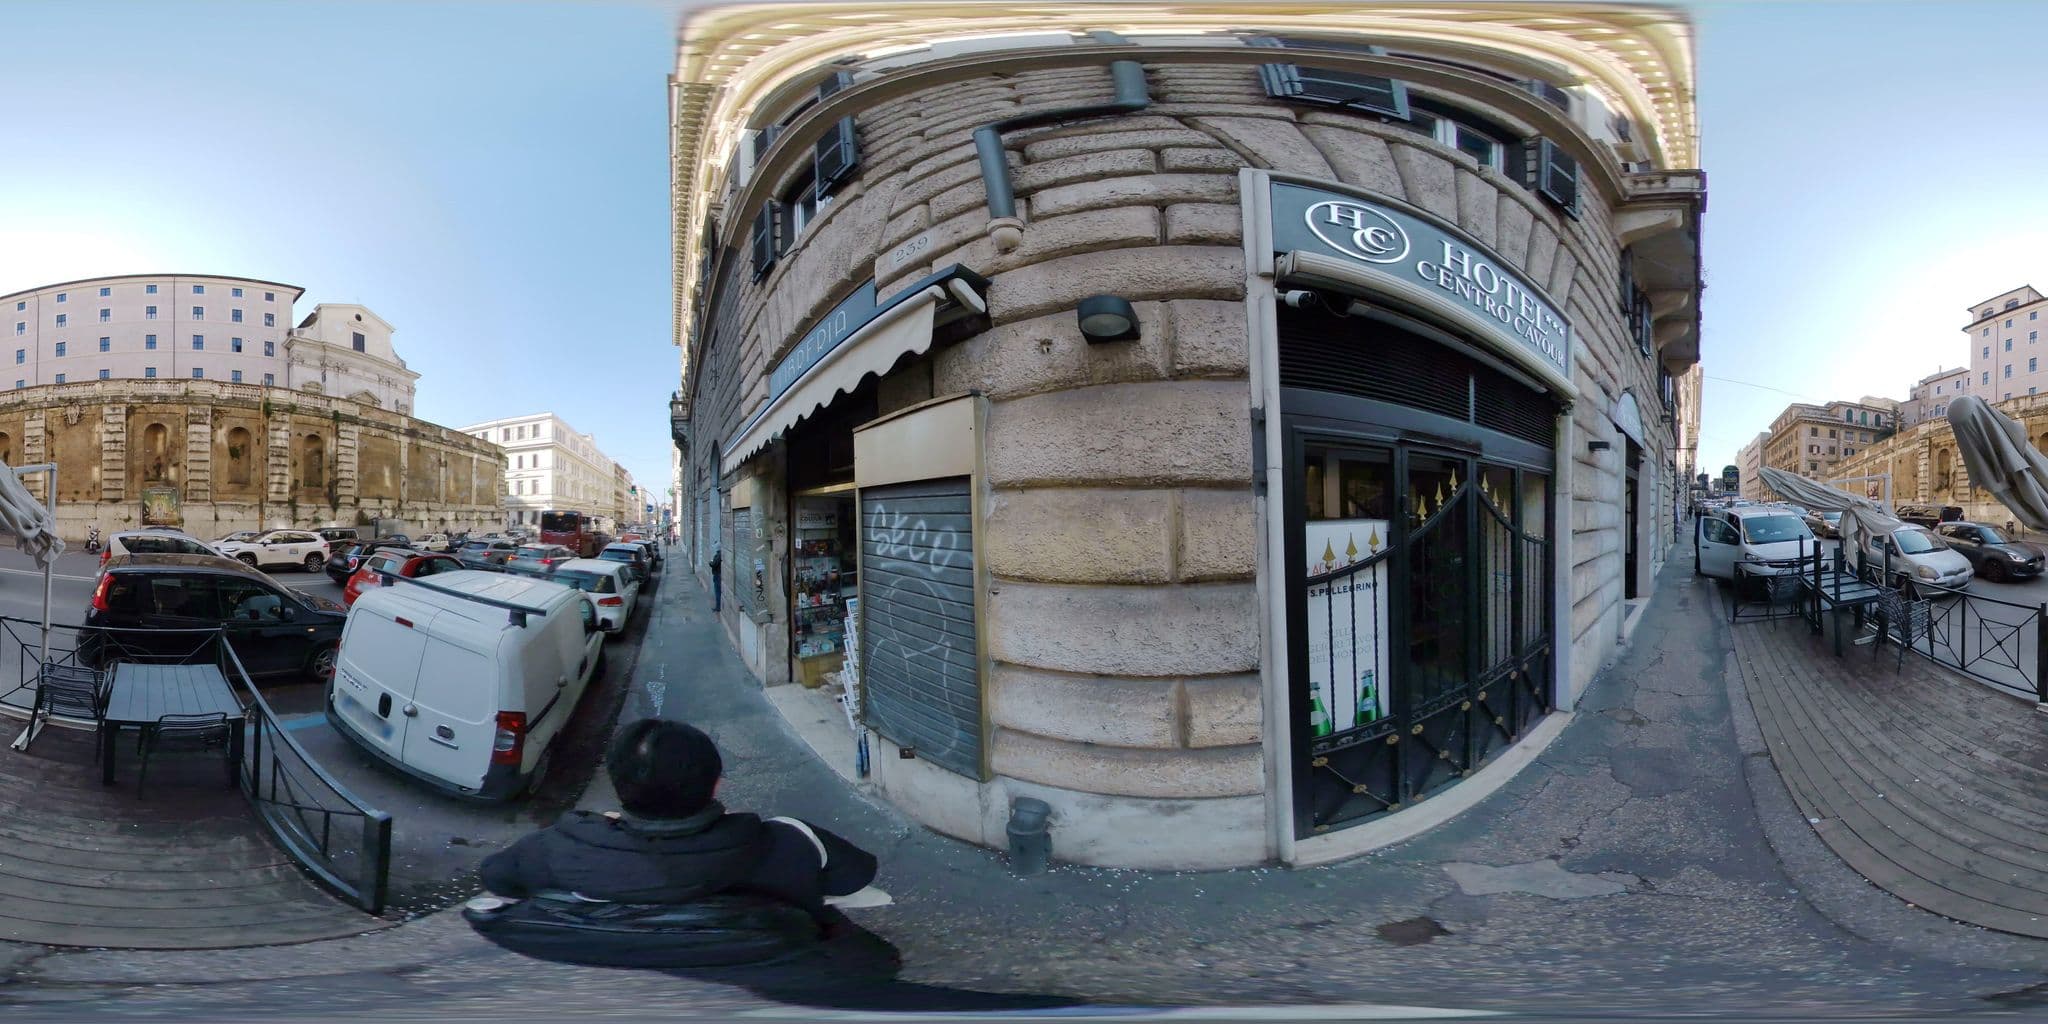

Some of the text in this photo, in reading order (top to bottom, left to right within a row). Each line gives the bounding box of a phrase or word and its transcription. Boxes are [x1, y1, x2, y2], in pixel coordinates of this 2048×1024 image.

[896, 236, 928, 262] 239
[1439, 239, 1548, 336] HOTEL
[1416, 260, 1564, 367] CENTRO CAVOUR
